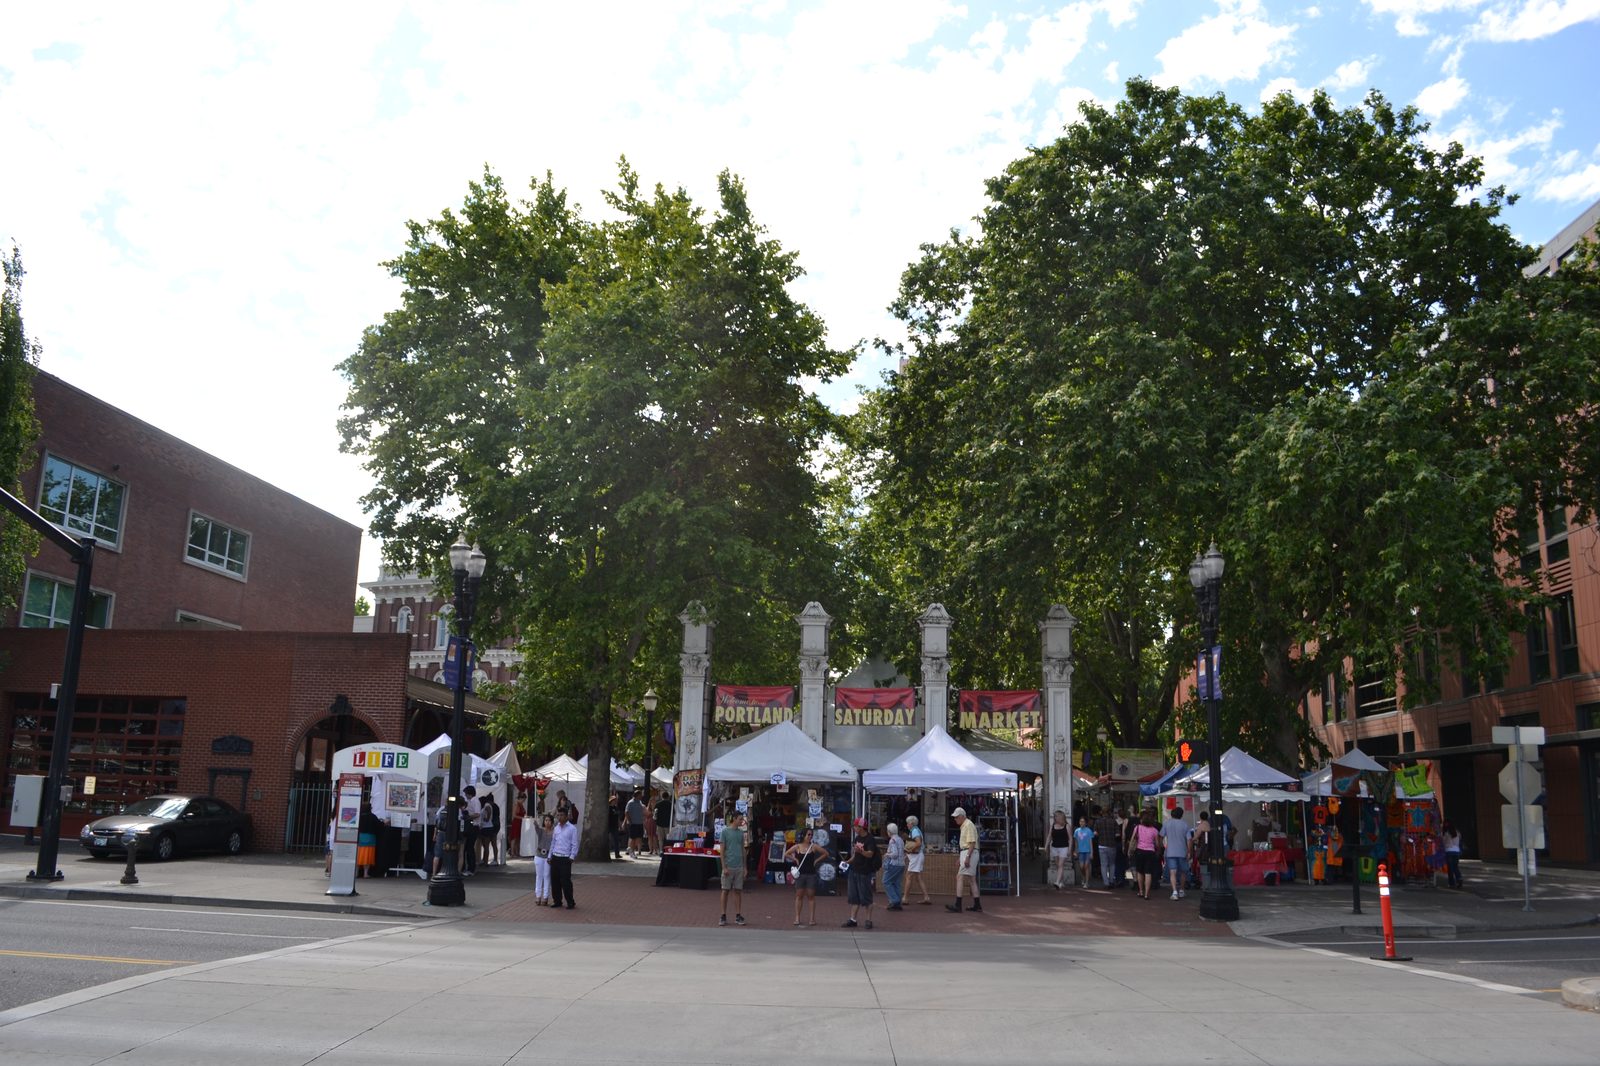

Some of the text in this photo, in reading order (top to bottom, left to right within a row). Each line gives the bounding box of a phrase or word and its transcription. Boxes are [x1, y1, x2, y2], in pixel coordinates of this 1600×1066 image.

[714, 705, 794, 724] PORTLAND
[834, 708, 915, 726] SATURDAY
[959, 710, 1041, 729] MARKET
[354, 752, 408, 768] LIFE
